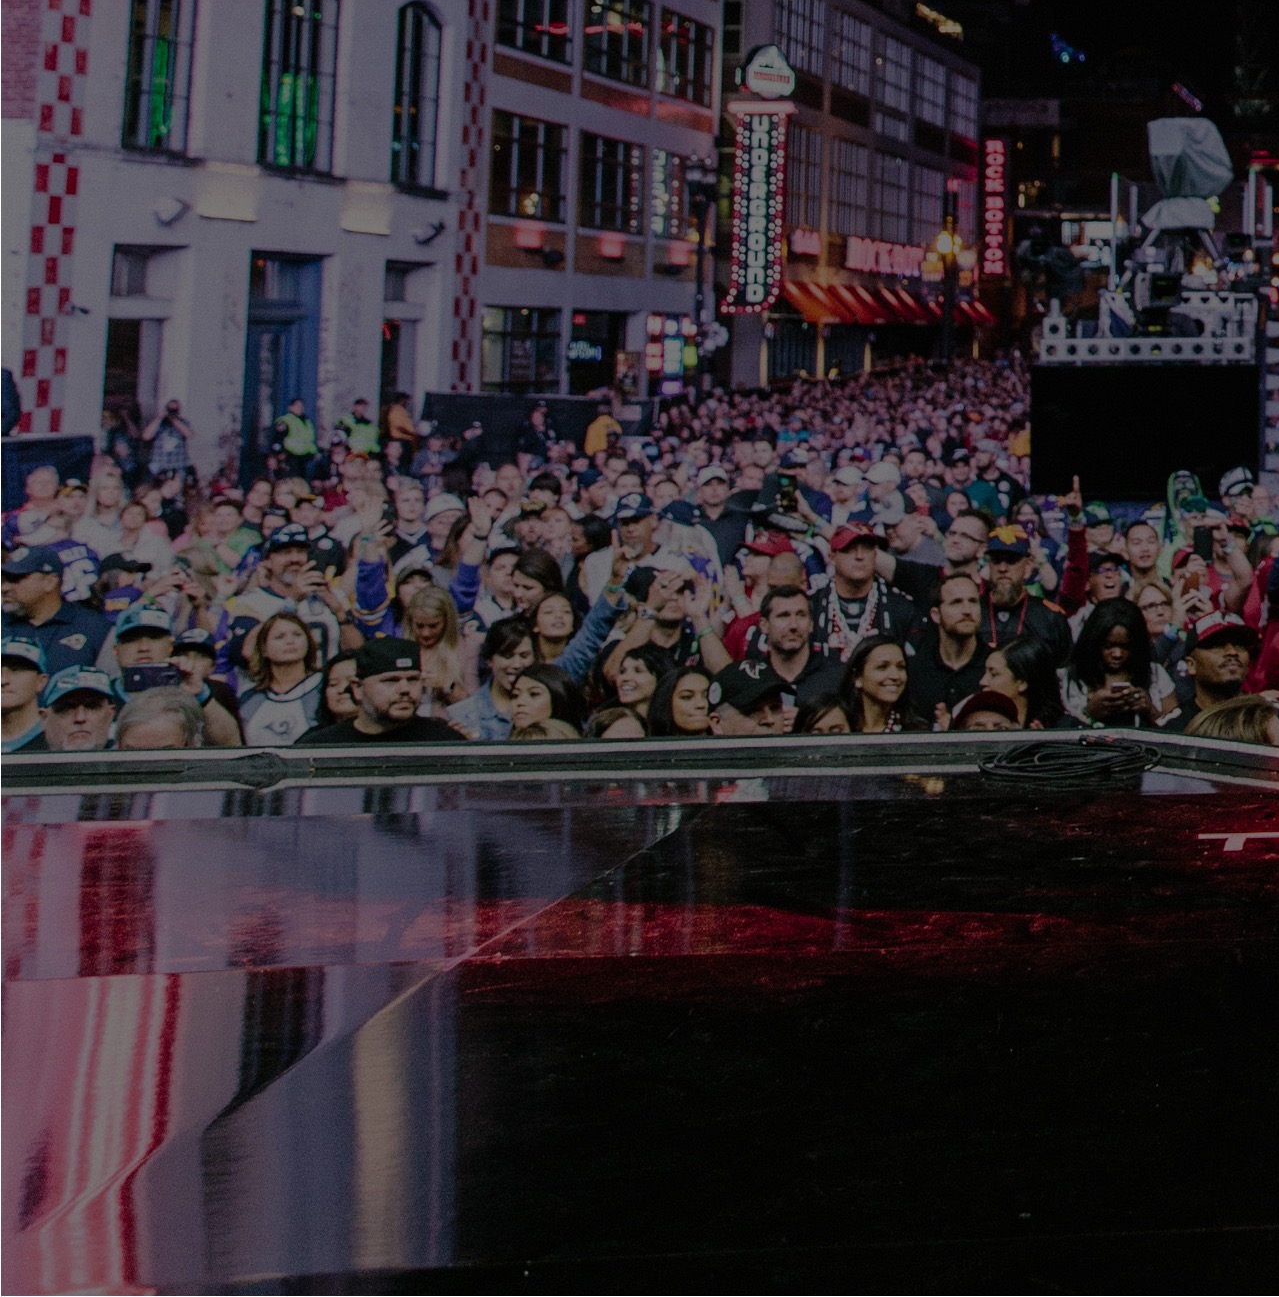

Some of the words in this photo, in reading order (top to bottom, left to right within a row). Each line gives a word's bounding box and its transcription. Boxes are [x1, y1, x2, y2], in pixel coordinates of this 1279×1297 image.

[984, 139, 1005, 193] ROCK
[745, 114, 772, 303] UNDERGROUND
[983, 195, 1005, 274] BOTTOM
